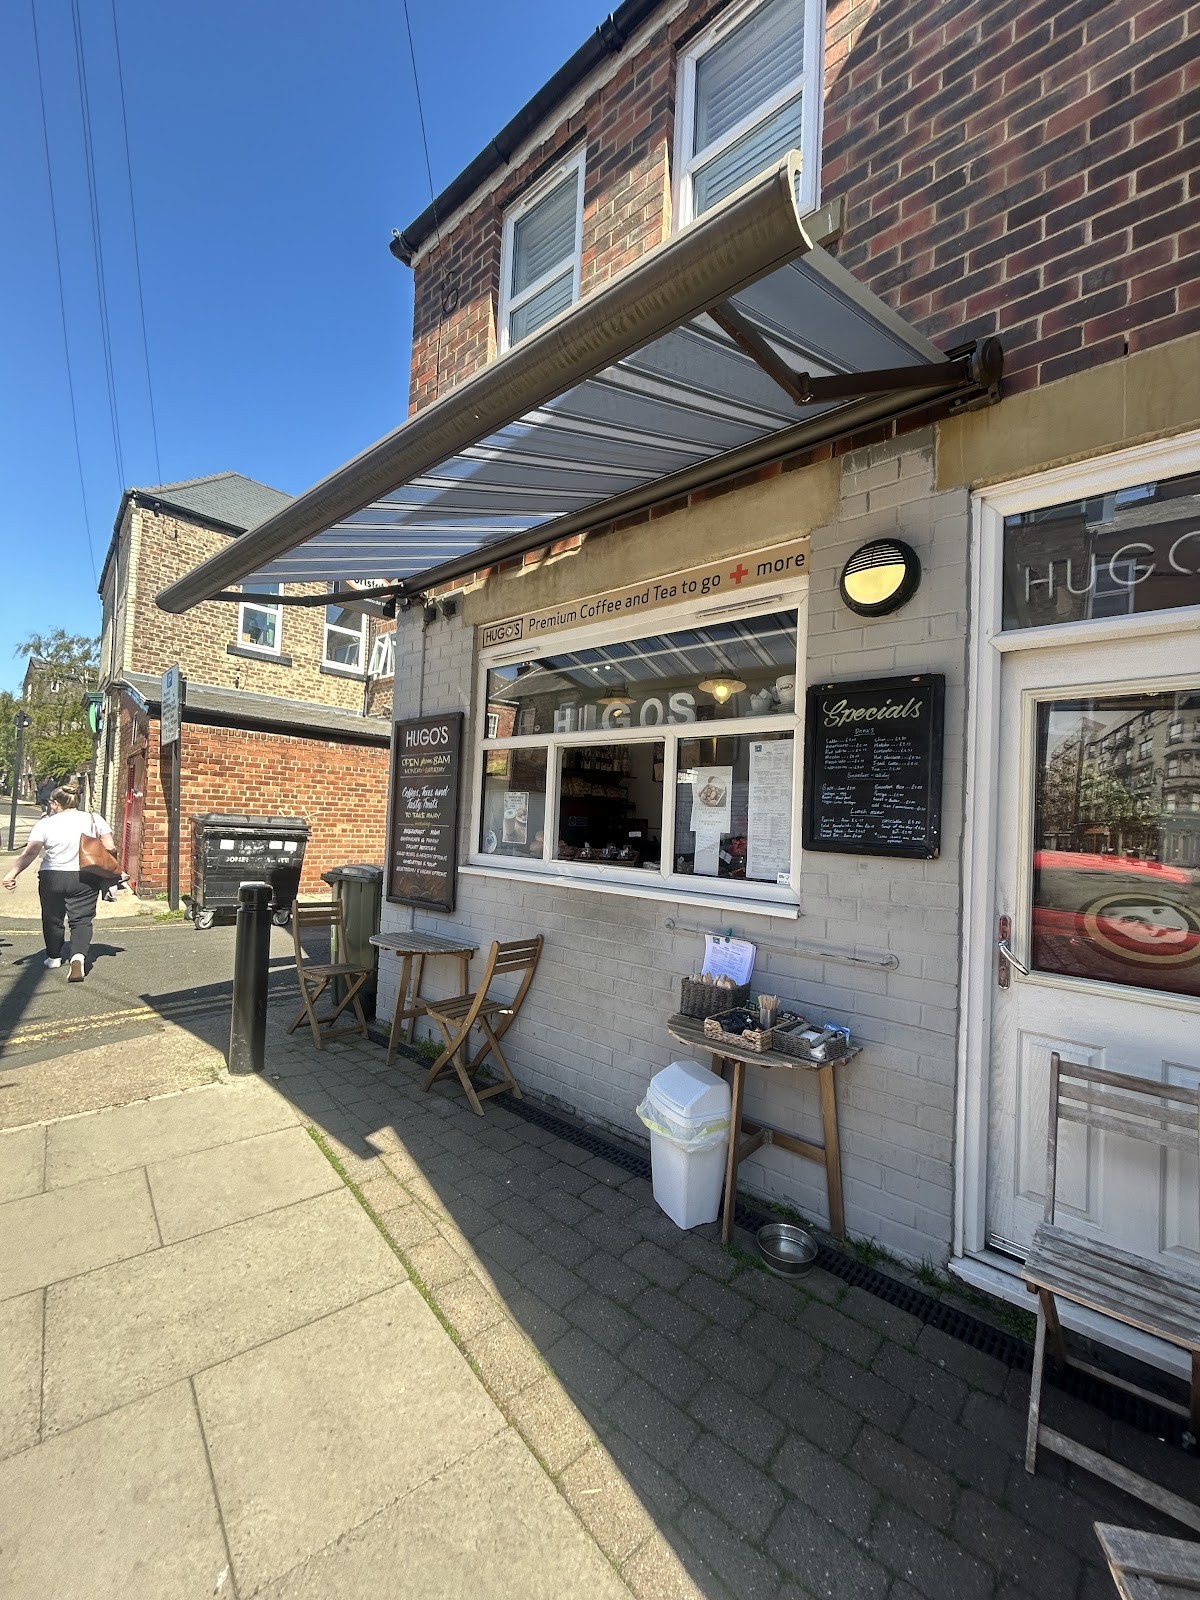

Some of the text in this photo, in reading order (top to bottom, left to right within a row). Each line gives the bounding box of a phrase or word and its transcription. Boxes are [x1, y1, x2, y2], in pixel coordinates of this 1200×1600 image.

[485, 623, 520, 643] HUGO'S
[529, 611, 577, 631] Premium
[580, 599, 622, 618] Coffee
[625, 589, 649, 608] and
[653, 585, 677, 601] Tea
[682, 580, 697, 594] to
[701, 574, 721, 594] go
[756, 553, 806, 576] more
[823, 697, 923, 727] Specials
[406, 726, 449, 747] HUGO'S
[402, 758, 419, 766] OPEN
[433, 755, 450, 765] 8AM
[434, 785, 450, 796] and
